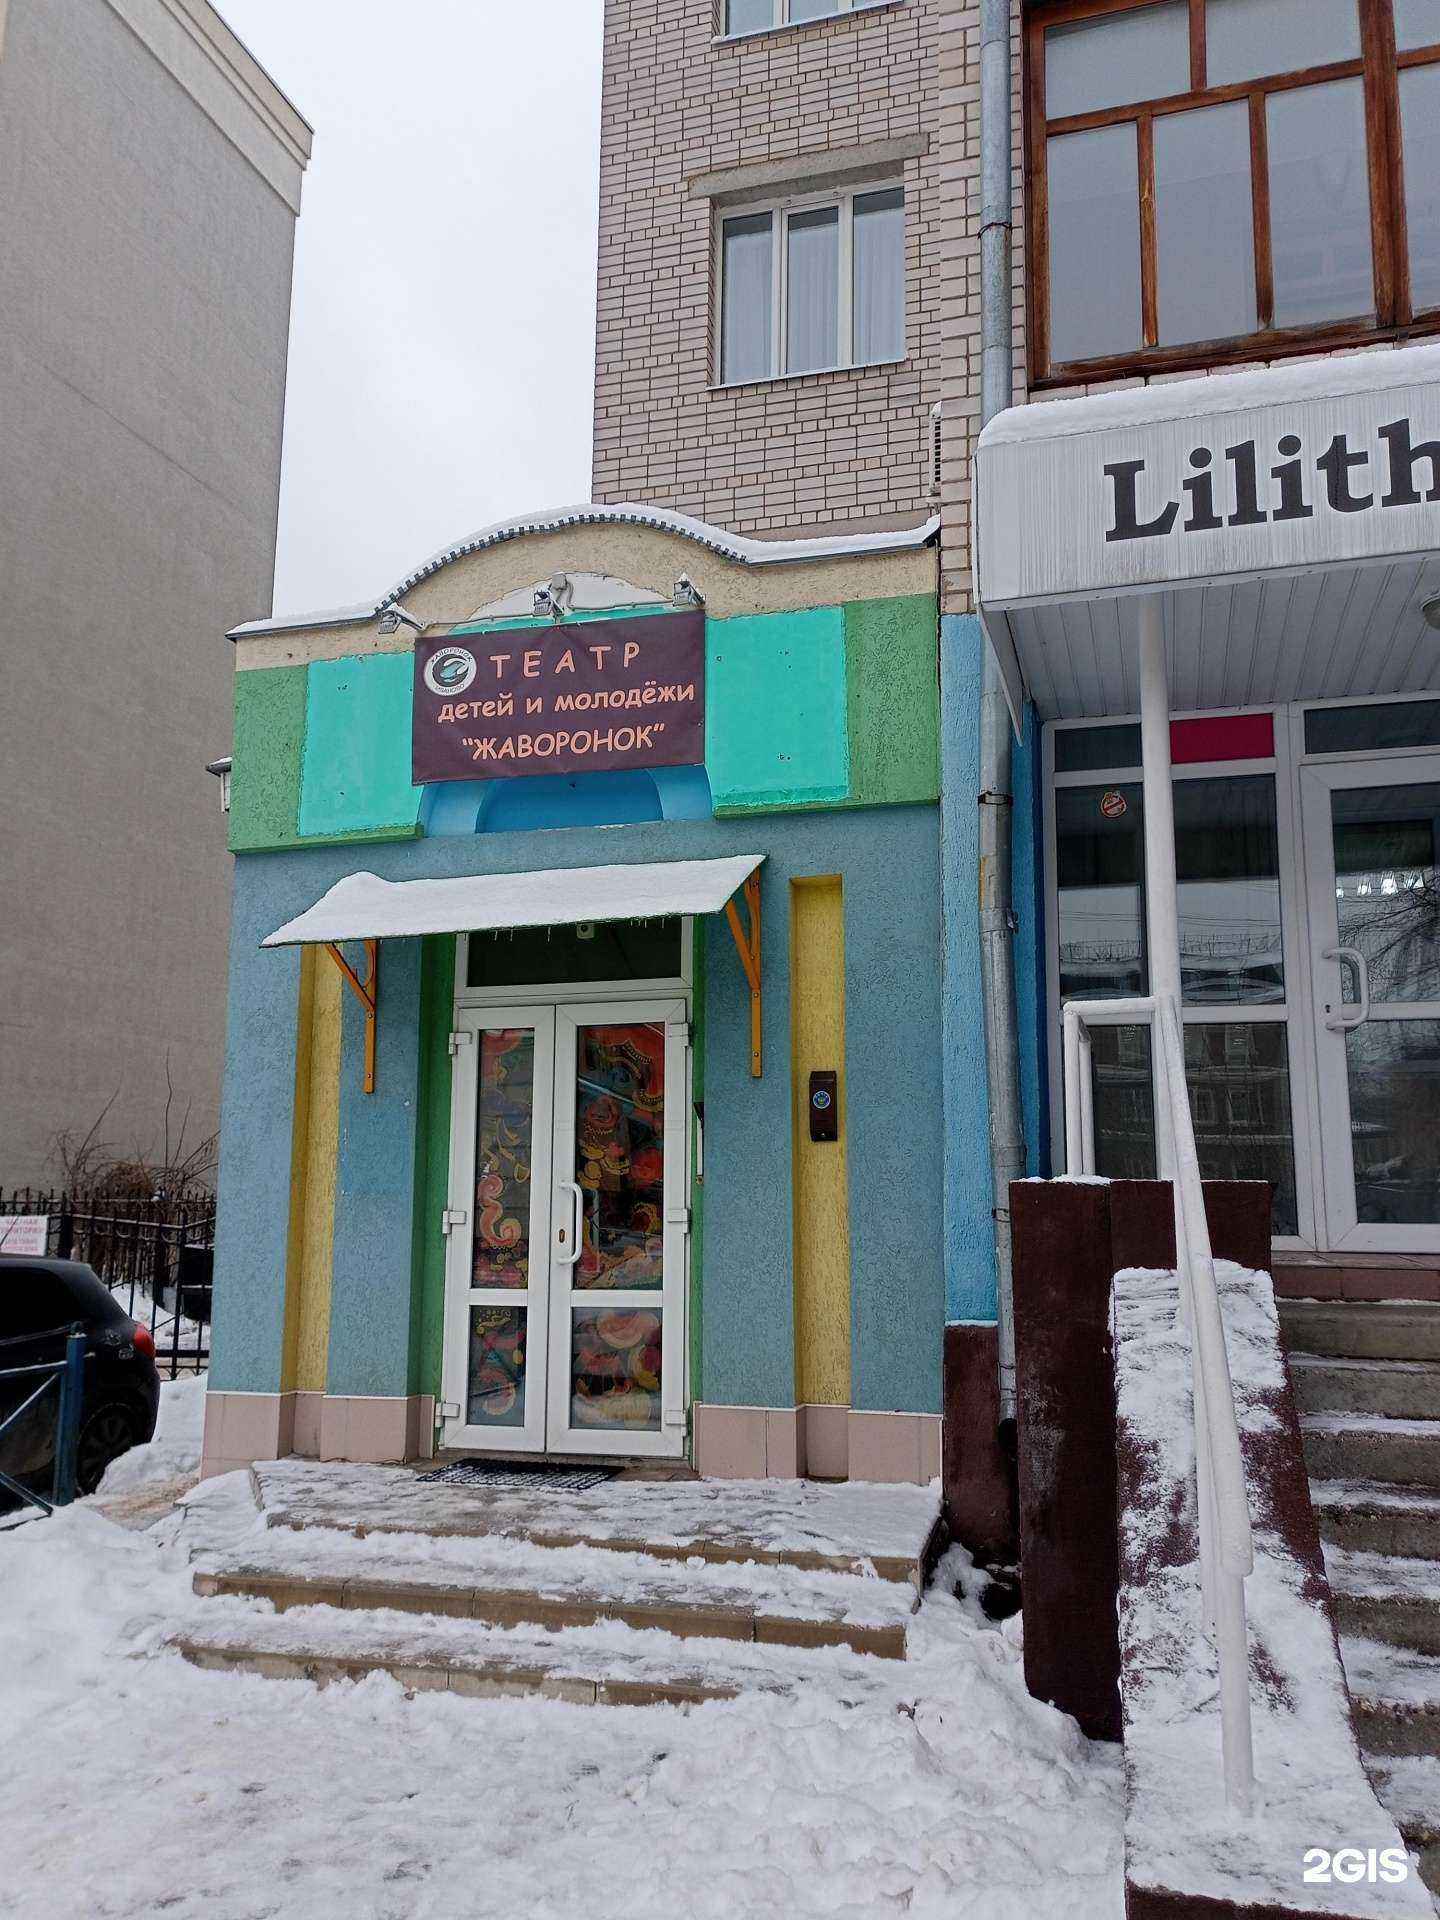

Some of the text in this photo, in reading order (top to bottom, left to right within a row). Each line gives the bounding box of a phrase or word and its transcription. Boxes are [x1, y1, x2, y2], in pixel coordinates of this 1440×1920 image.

[1103, 417, 1440, 542] Lilith
[489, 641, 640, 679] ТЕАТР
[438, 680, 695, 723] детей и молодёжи
